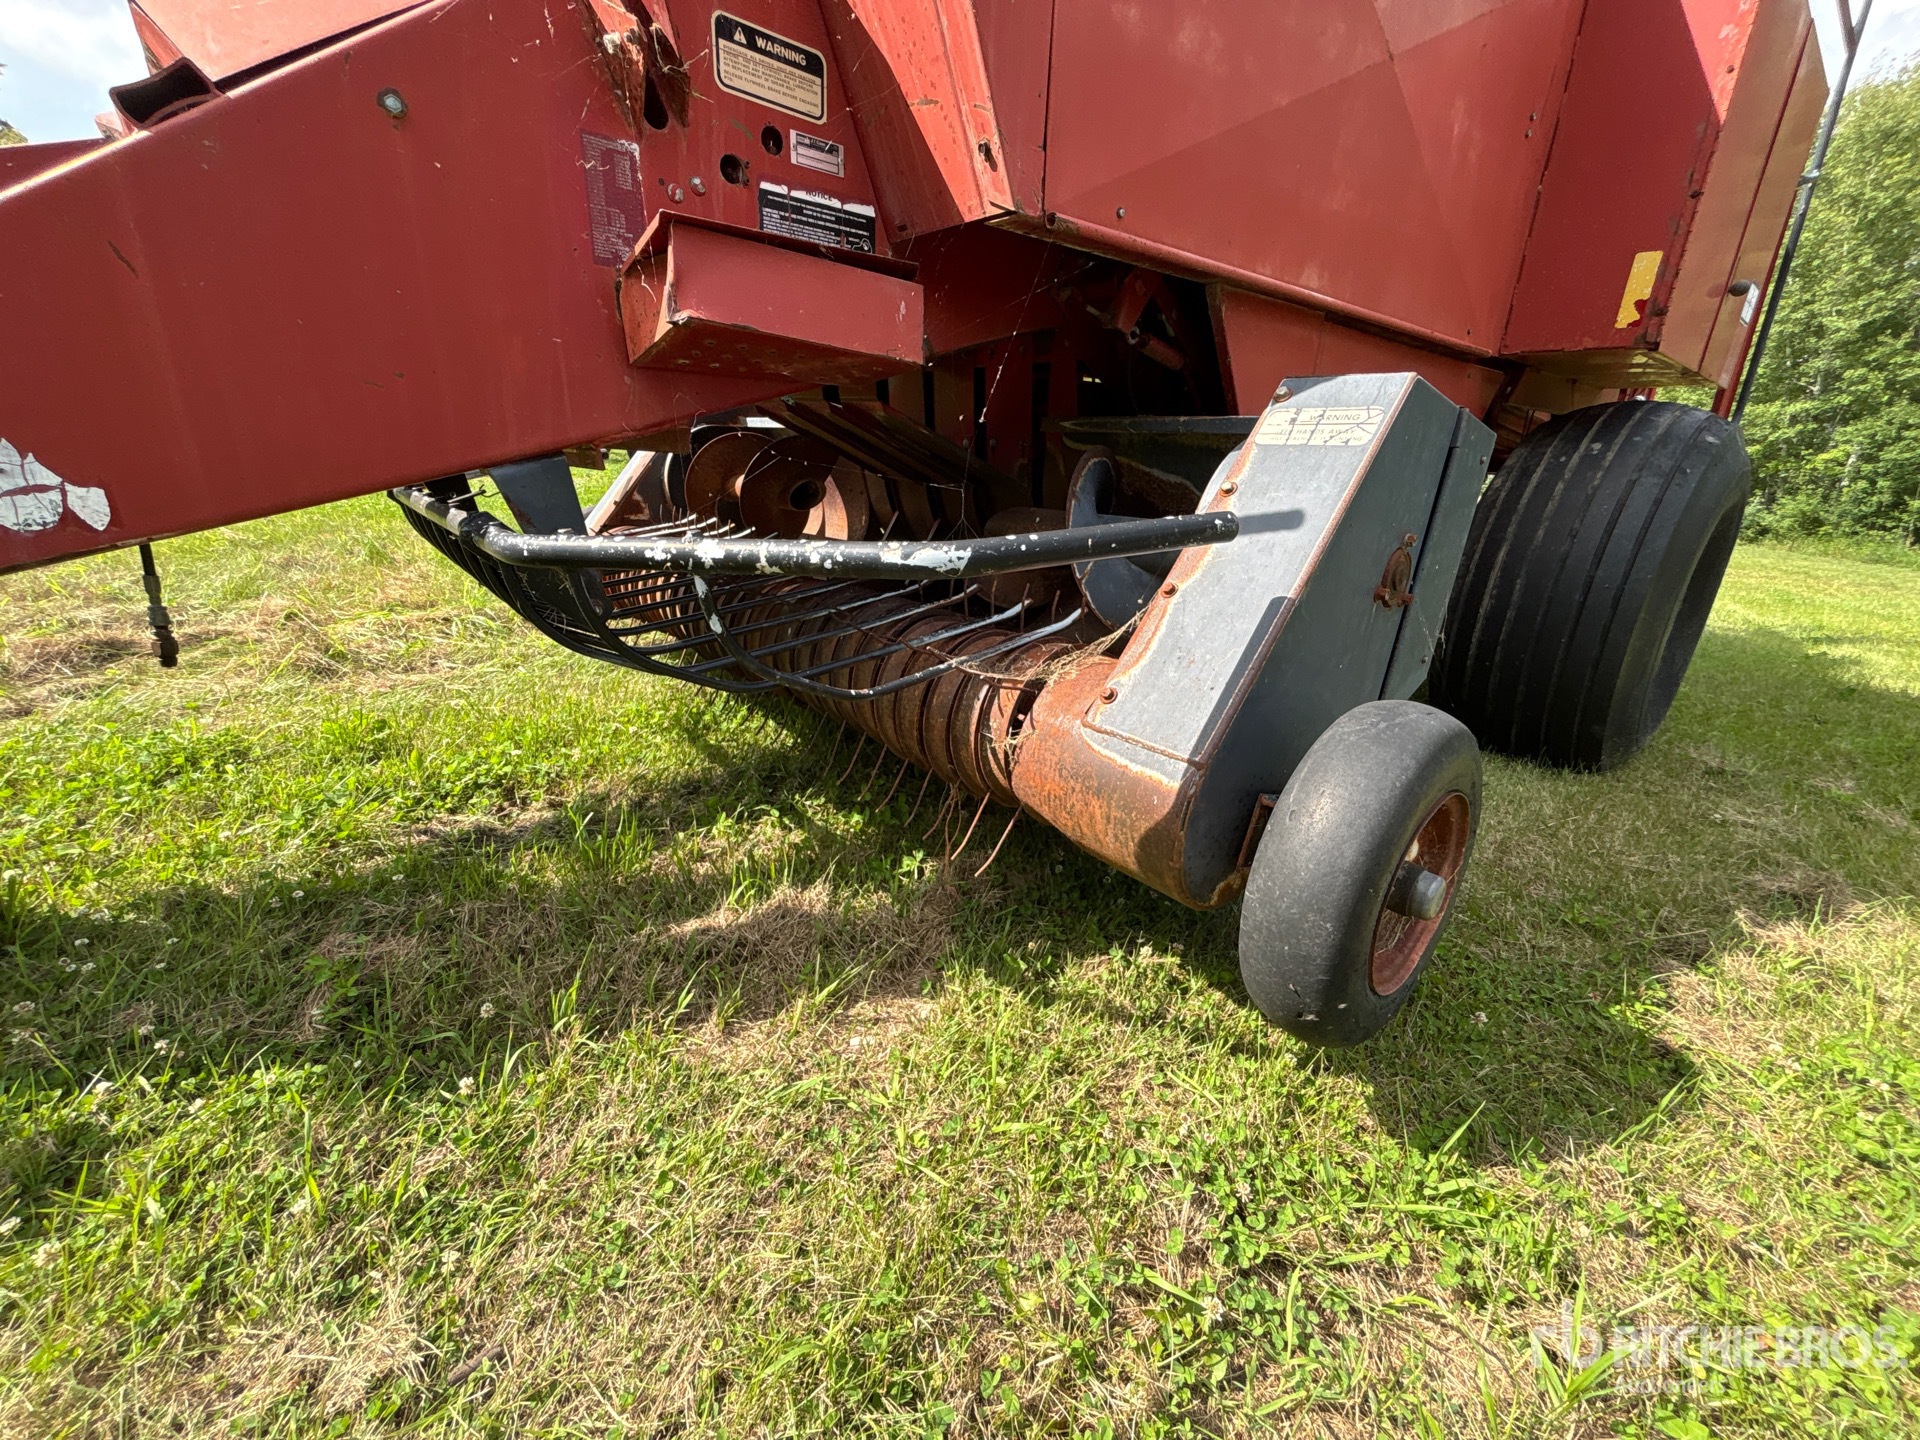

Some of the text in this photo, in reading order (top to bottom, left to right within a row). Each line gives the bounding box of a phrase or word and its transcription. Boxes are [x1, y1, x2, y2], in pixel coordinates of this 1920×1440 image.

[755, 35, 807, 66] WARNING
[723, 56, 749, 70] ATTEMPTING
[792, 82, 817, 95] LUBRICATION
[723, 69, 818, 108] RELEASE FLYWHEEL BRAKE BEFORE ENGAGING
[731, 64, 762, 80] REPLACEMENT
[771, 79, 784, 88] SHEAR
[784, 74, 796, 82] BRAKE
[805, 191, 833, 201] NOTICE
